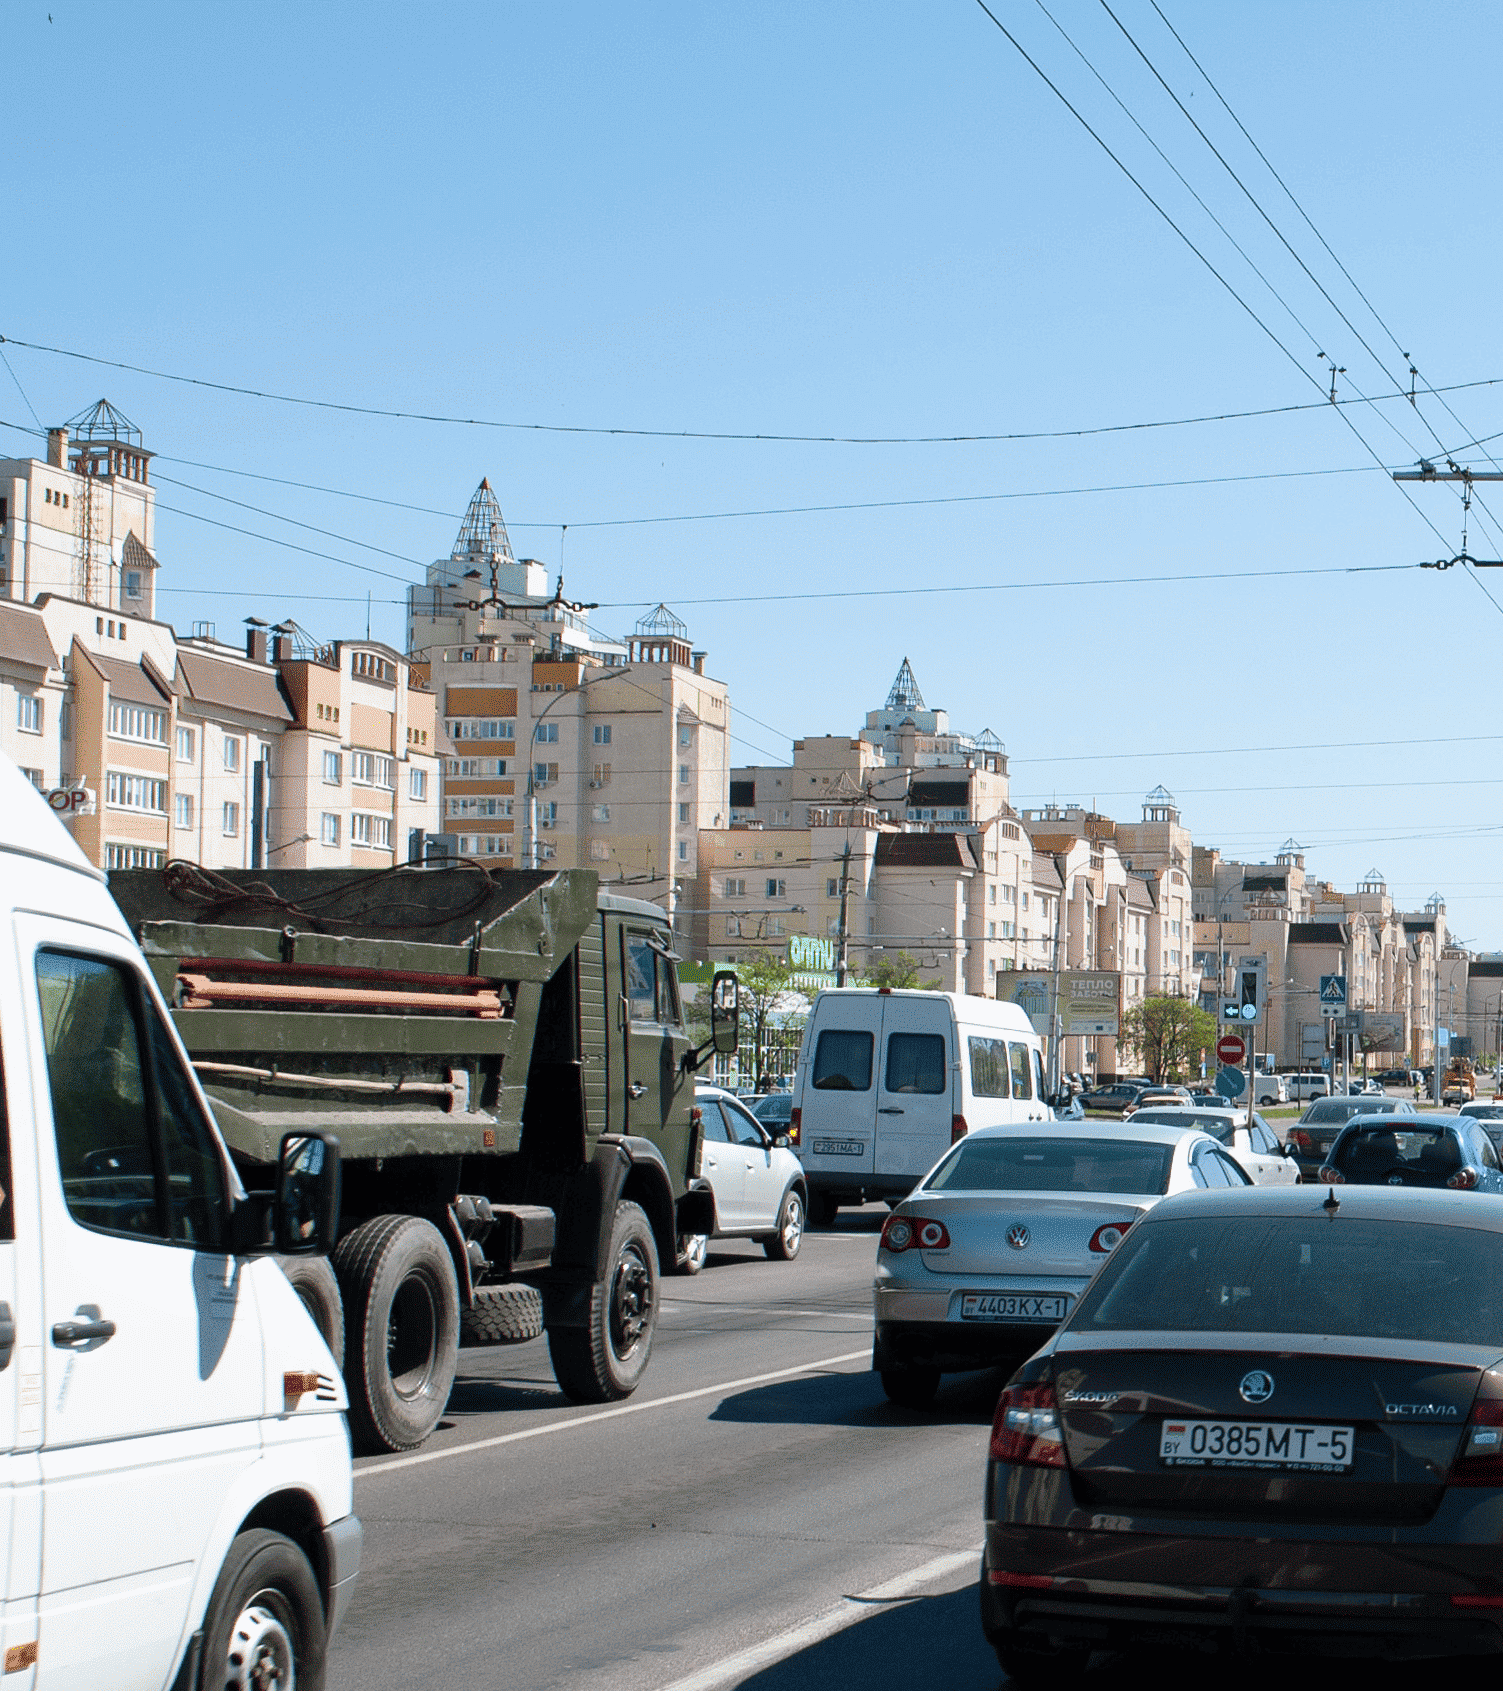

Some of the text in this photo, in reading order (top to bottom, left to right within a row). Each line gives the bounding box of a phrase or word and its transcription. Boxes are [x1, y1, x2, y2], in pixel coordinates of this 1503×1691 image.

[40, 790, 86, 810] ОР
[1071, 980, 1114, 989] ТЕПЛО
[1071, 990, 1113, 998] ЗАБОТЫ
[1385, 1403, 1458, 1415] OCTAVIA
[1164, 1442, 1180, 1454] BY
